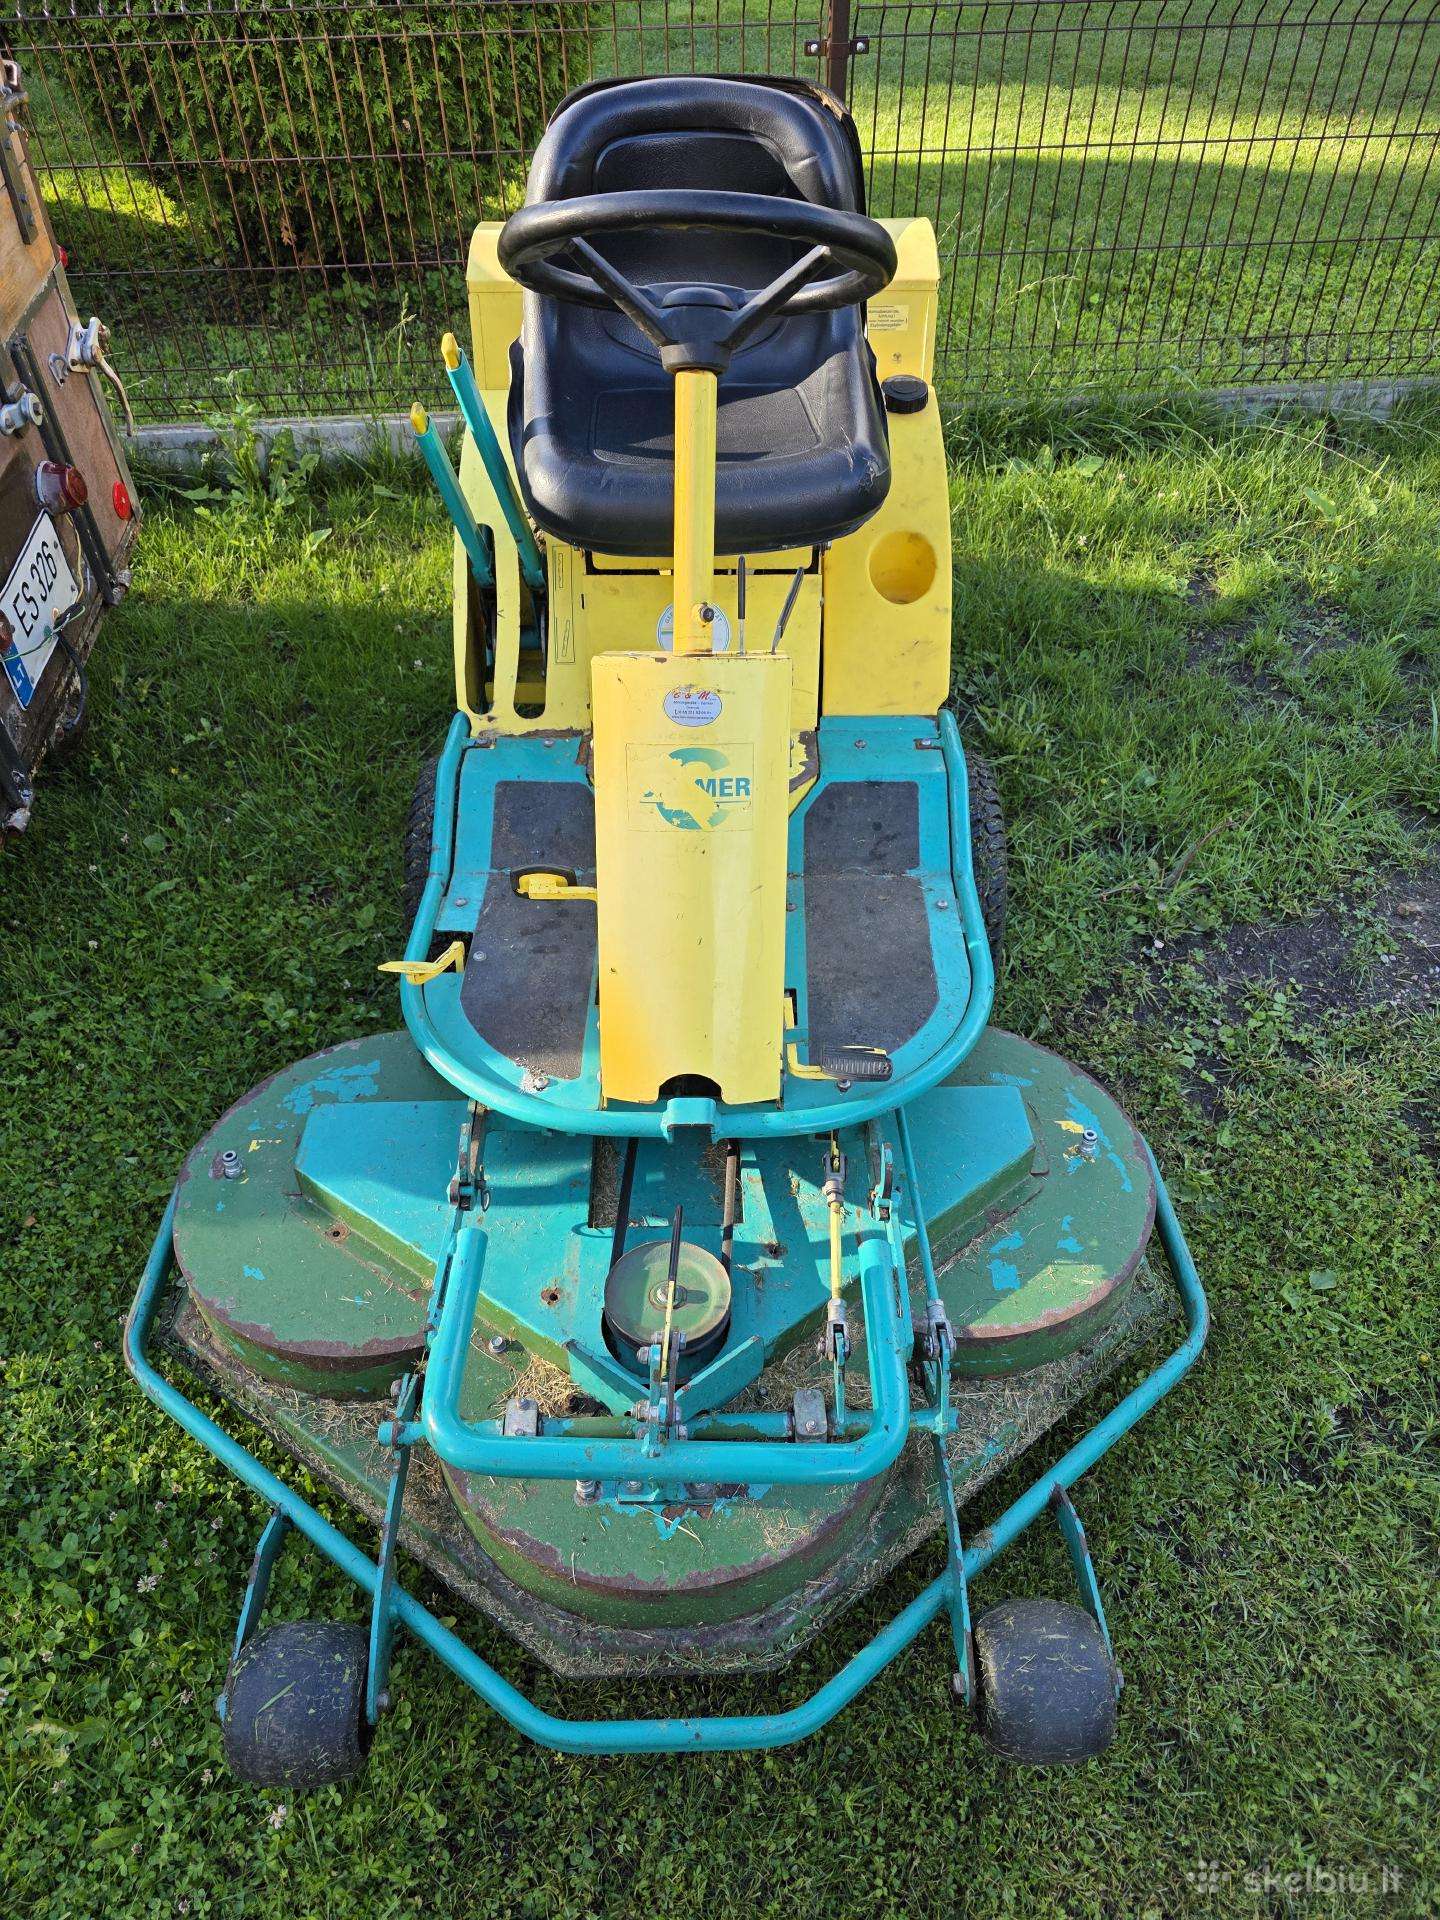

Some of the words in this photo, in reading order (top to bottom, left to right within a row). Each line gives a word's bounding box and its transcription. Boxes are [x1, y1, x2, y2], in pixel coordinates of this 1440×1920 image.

[12, 581, 39, 638] ES
[30, 541, 57, 602] 326
[13, 663, 25, 688] LT
